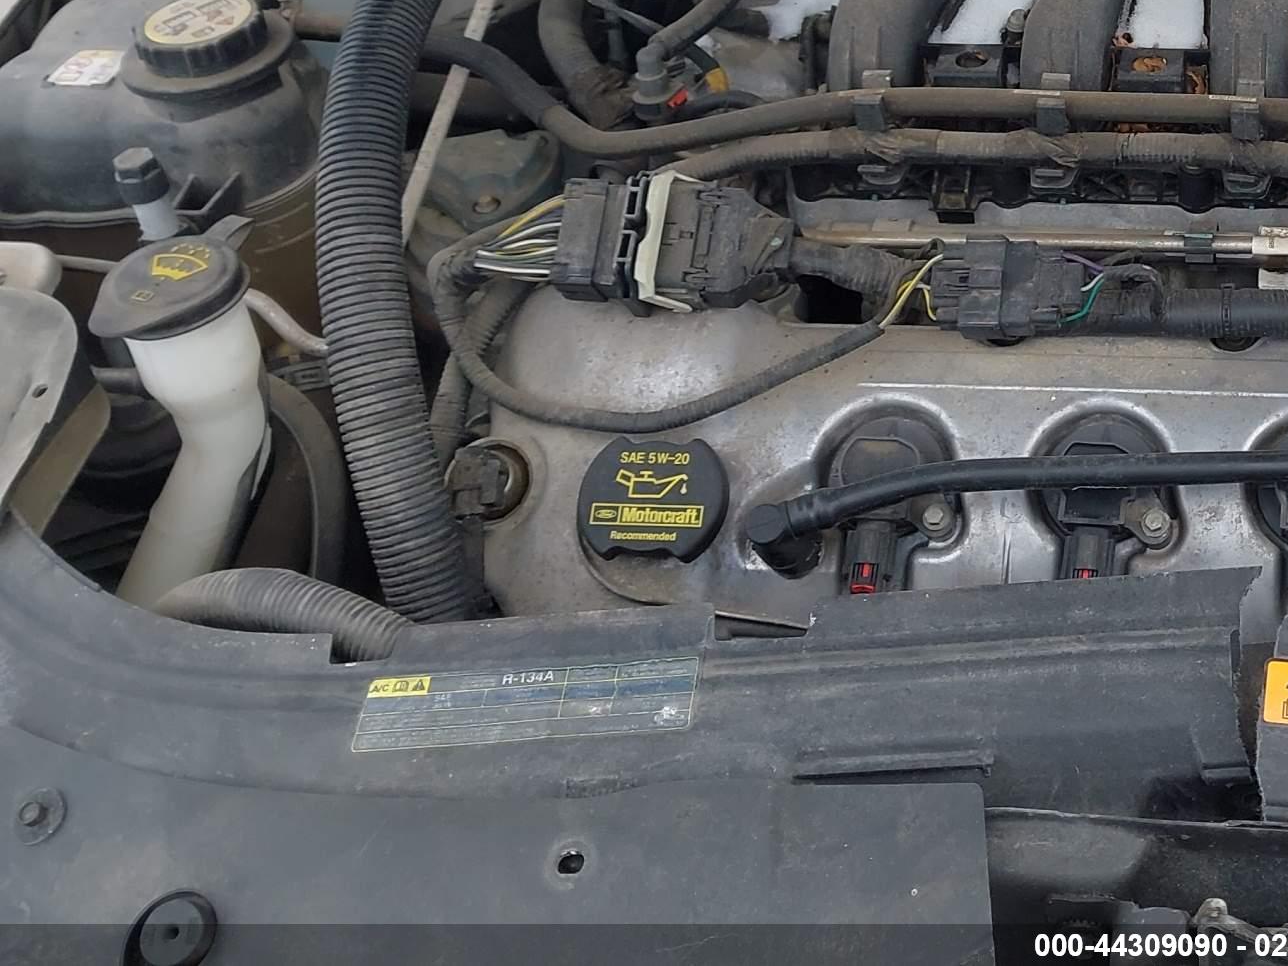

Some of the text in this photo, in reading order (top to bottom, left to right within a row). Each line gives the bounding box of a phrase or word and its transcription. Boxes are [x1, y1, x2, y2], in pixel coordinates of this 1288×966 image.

[620, 451, 690, 465] SAE 5W-20
[622, 507, 699, 524] Motorcraft
[609, 530, 677, 541] Recommended
[502, 670, 555, 685] R-134A
[369, 680, 390, 693] A/C
